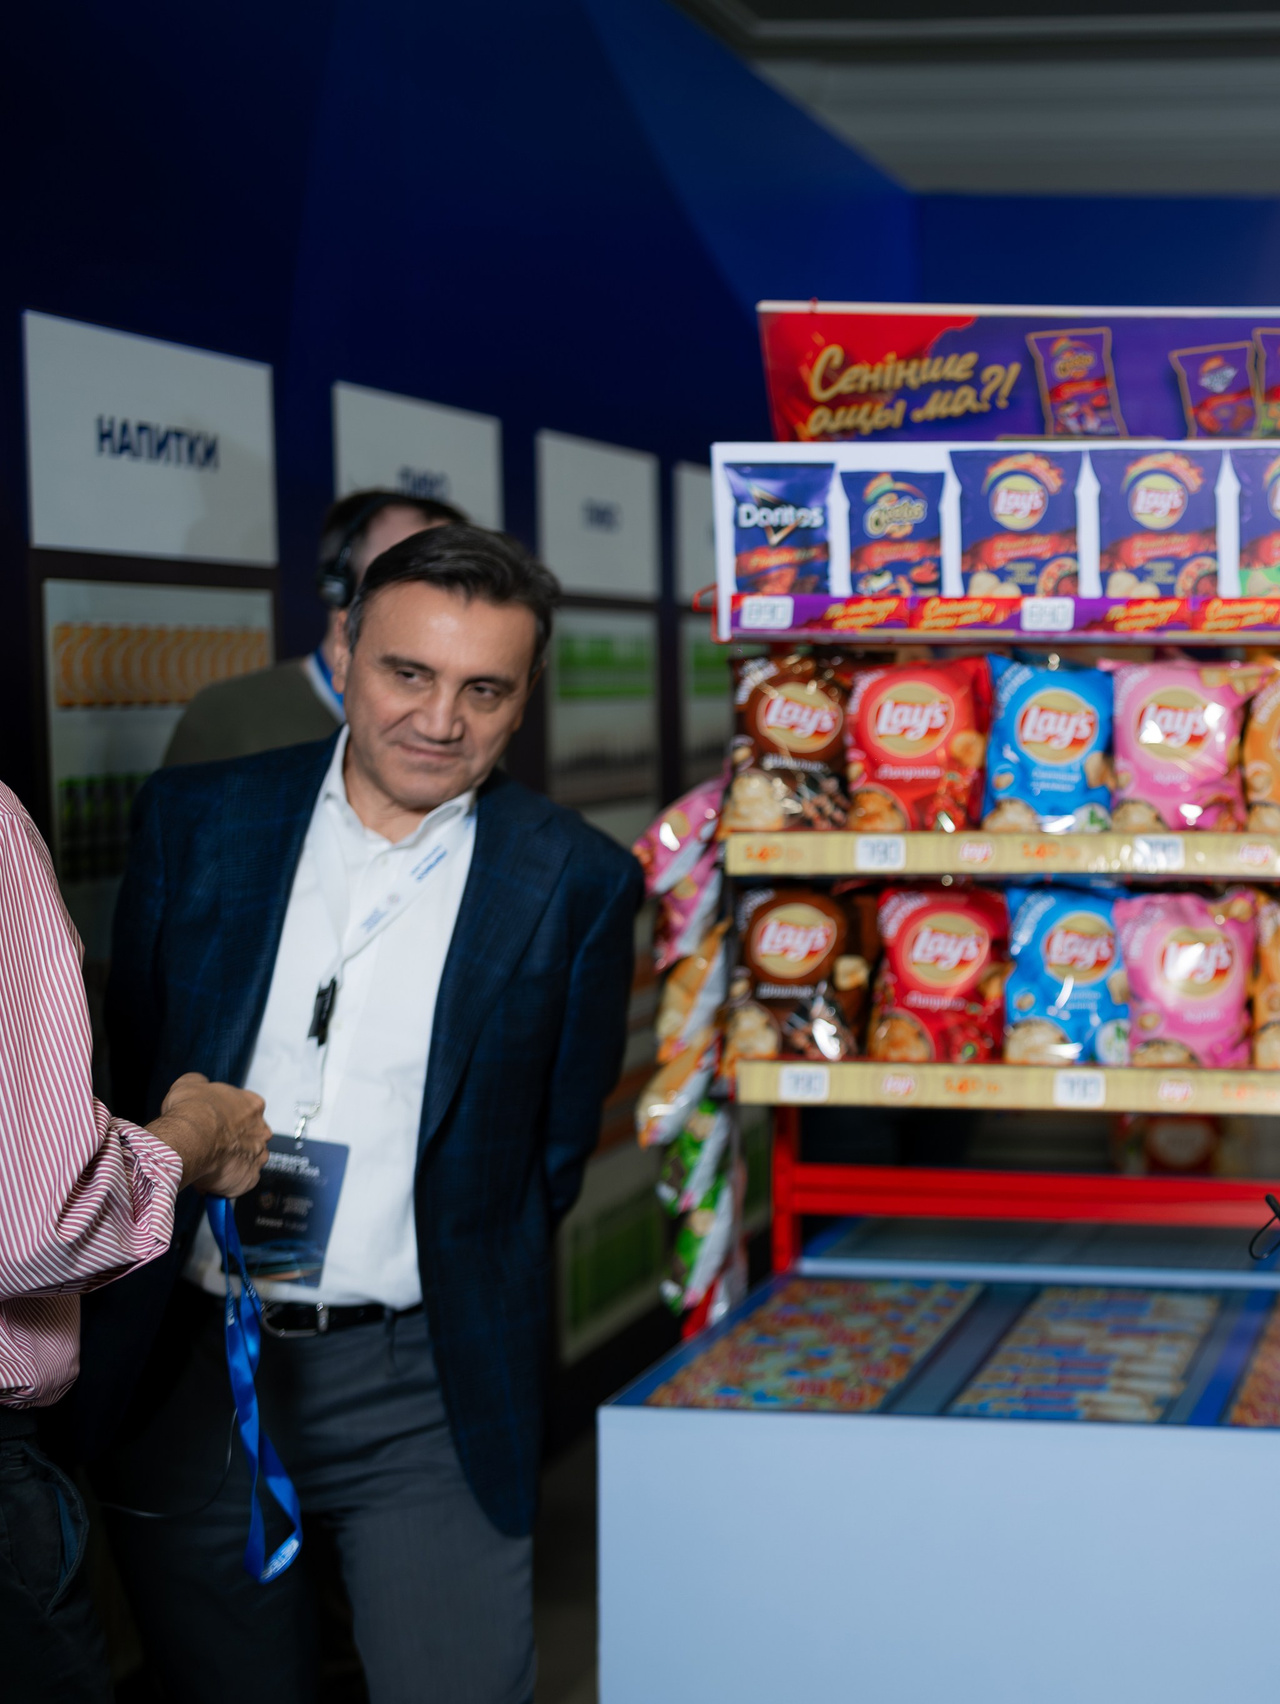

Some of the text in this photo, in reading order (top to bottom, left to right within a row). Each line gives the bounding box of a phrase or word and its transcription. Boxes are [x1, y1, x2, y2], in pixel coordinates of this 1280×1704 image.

[97, 414, 220, 474] НАПИТКИ
[738, 503, 825, 528] Doritos
[765, 695, 837, 738] Lay's
[876, 699, 949, 741] Lay's
[1020, 705, 1095, 750] Lay's
[759, 919, 831, 962] Lay's
[913, 926, 983, 970] Lay's
[1047, 929, 1113, 971] Lay's
[1163, 941, 1232, 984] Ly's
